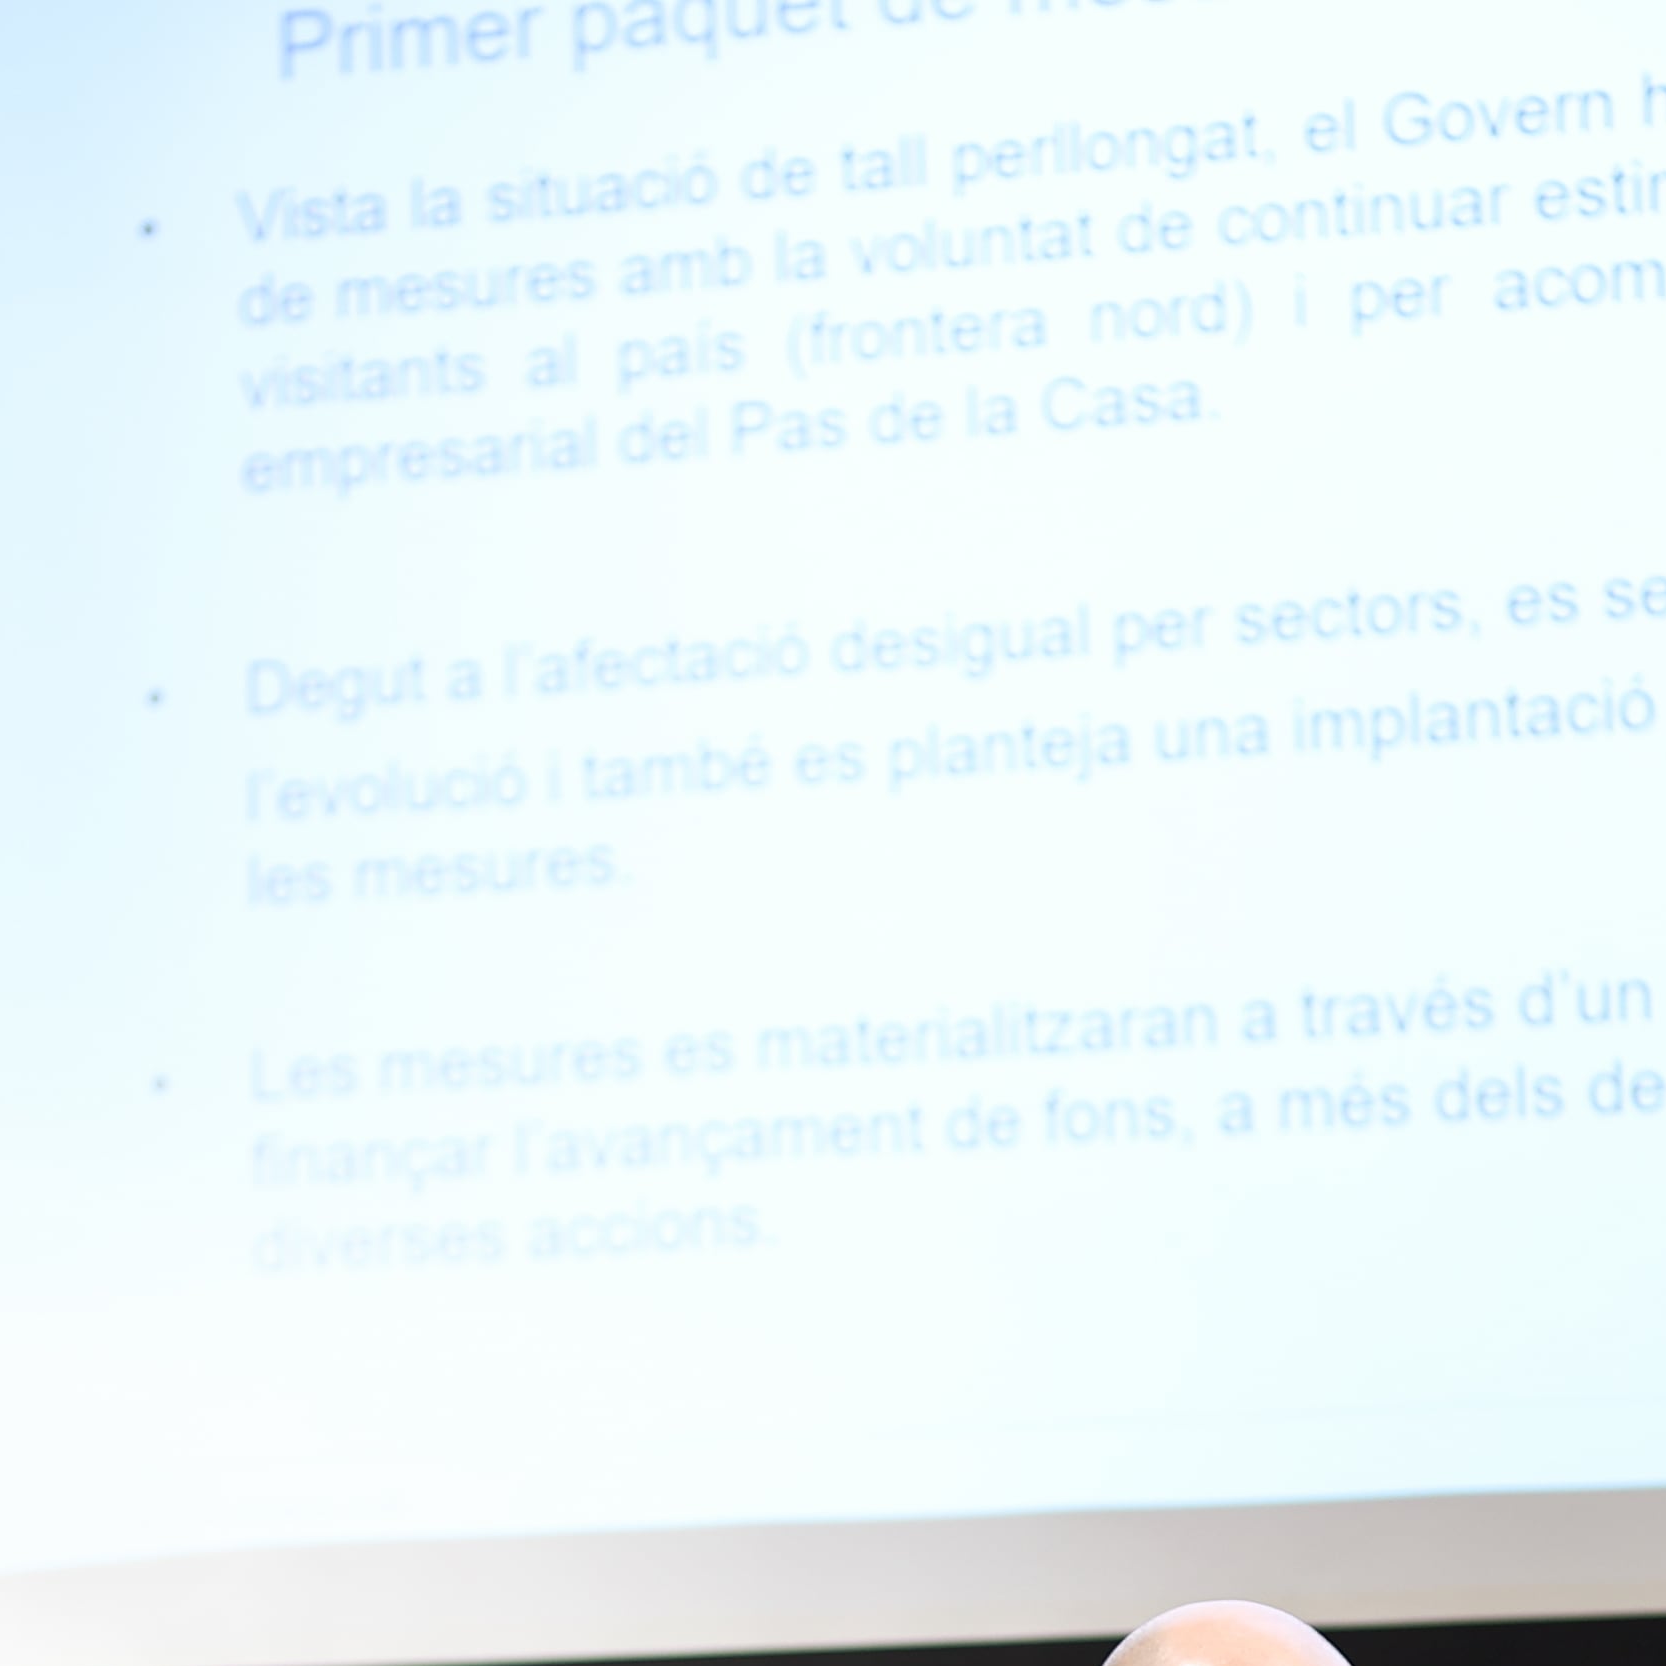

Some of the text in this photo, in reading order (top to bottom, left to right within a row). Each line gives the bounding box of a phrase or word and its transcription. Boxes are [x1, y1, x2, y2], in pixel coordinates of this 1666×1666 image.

[280, 7, 541, 79] Primer
[237, 190, 386, 242] Vista
[412, 180, 461, 228] la
[488, 153, 716, 223] situació
[742, 153, 814, 200] de
[841, 139, 924, 191] tall
[954, 114, 1274, 193] perllongat,
[1305, 101, 1353, 153] el
[1384, 90, 1612, 146] Govern
[240, 277, 312, 327] de
[337, 260, 596, 314] mesures
[621, 241, 750, 296] amb
[777, 235, 825, 281] la
[854, 213, 1092, 275] voluntat
[1120, 207, 1192, 254] de
[1219, 186, 1503, 246] continuar
[242, 350, 484, 409] visitants
[527, 337, 575, 389] al
[619, 332, 744, 390] país
[789, 307, 1046, 374] (frontera
[1092, 284, 1252, 346] nord)
[1294, 275, 1309, 326] i
[1352, 276, 1445, 335] per
[240, 376, 1220, 498] empresarial del Pas de la Casa.
[247, 656, 424, 723] Degut
[448, 659, 482, 701] a
[832, 605, 1088, 679] desigual
[1114, 607, 1209, 664] per
[1236, 588, 1483, 648] sectors,
[1506, 582, 1579, 626] es
[548, 751, 561, 803] i
[582, 732, 771, 800] també
[794, 743, 864, 785] es
[890, 724, 1131, 791] planteja
[1156, 714, 1269, 762] una
[1295, 687, 1656, 761] implantació
[248, 844, 634, 906] les mesures.
[251, 1050, 358, 1102] Les
[380, 1038, 642, 1090] mesures
[663, 1031, 734, 1076] es
[758, 1003, 1216, 1067] materialitzaran
[1242, 1000, 1276, 1042] a
[1300, 976, 1494, 1038] través
[252, 1135, 490, 1193] finançar
[947, 1101, 1020, 1150] de
[1044, 1090, 1191, 1143] fons,
[1218, 1092, 1254, 1136] a
[1279, 1076, 1411, 1129] més
[1434, 1067, 1564, 1122] dels
[253, 1206, 777, 1273] diverses accions.
